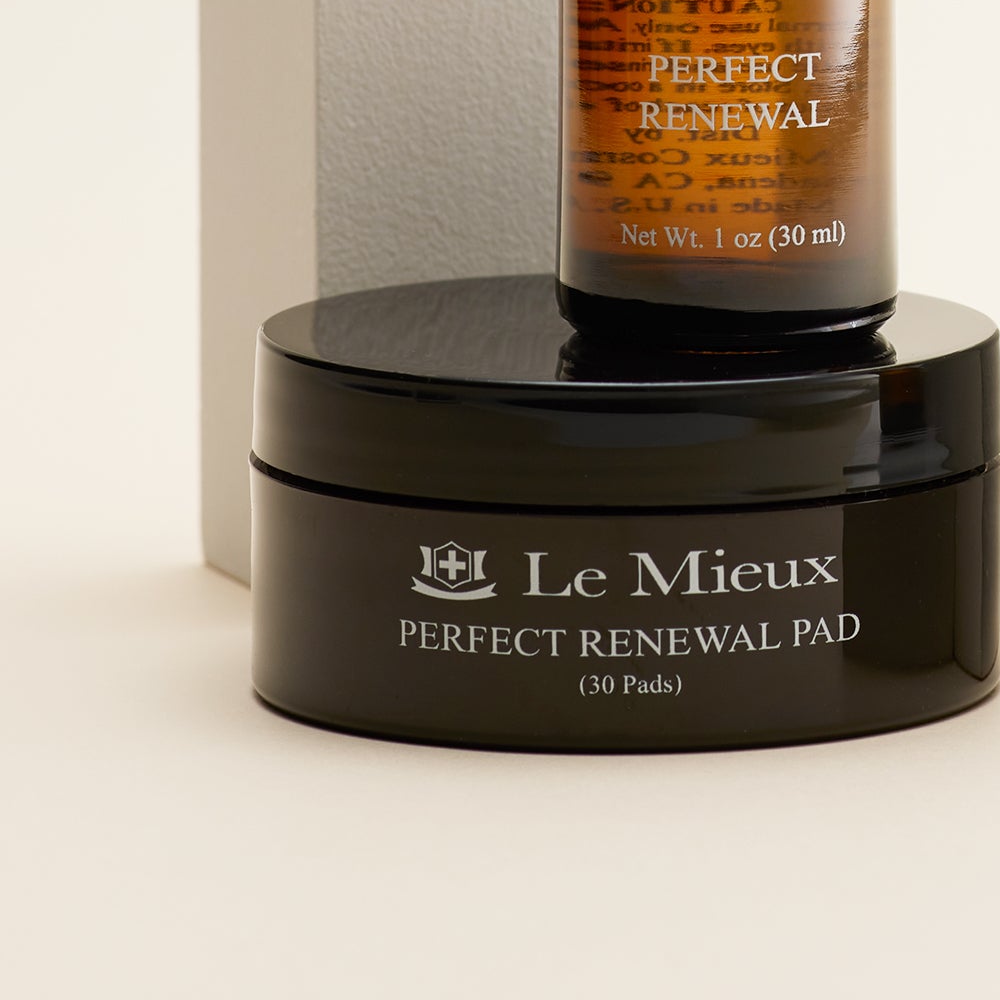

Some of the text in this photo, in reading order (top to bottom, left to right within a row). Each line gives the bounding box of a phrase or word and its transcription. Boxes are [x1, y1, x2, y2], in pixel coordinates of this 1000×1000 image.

[648, 52, 822, 83] PERFECT
[640, 99, 830, 131] RENEWAL
[621, 220, 845, 252] Net Wt. 1 oz (30 ml)
[523, 549, 838, 597] Le Mieux
[400, 613, 860, 657] PERFECT RENEWAL PAD
[580, 674, 682, 696] (30 Pads)
